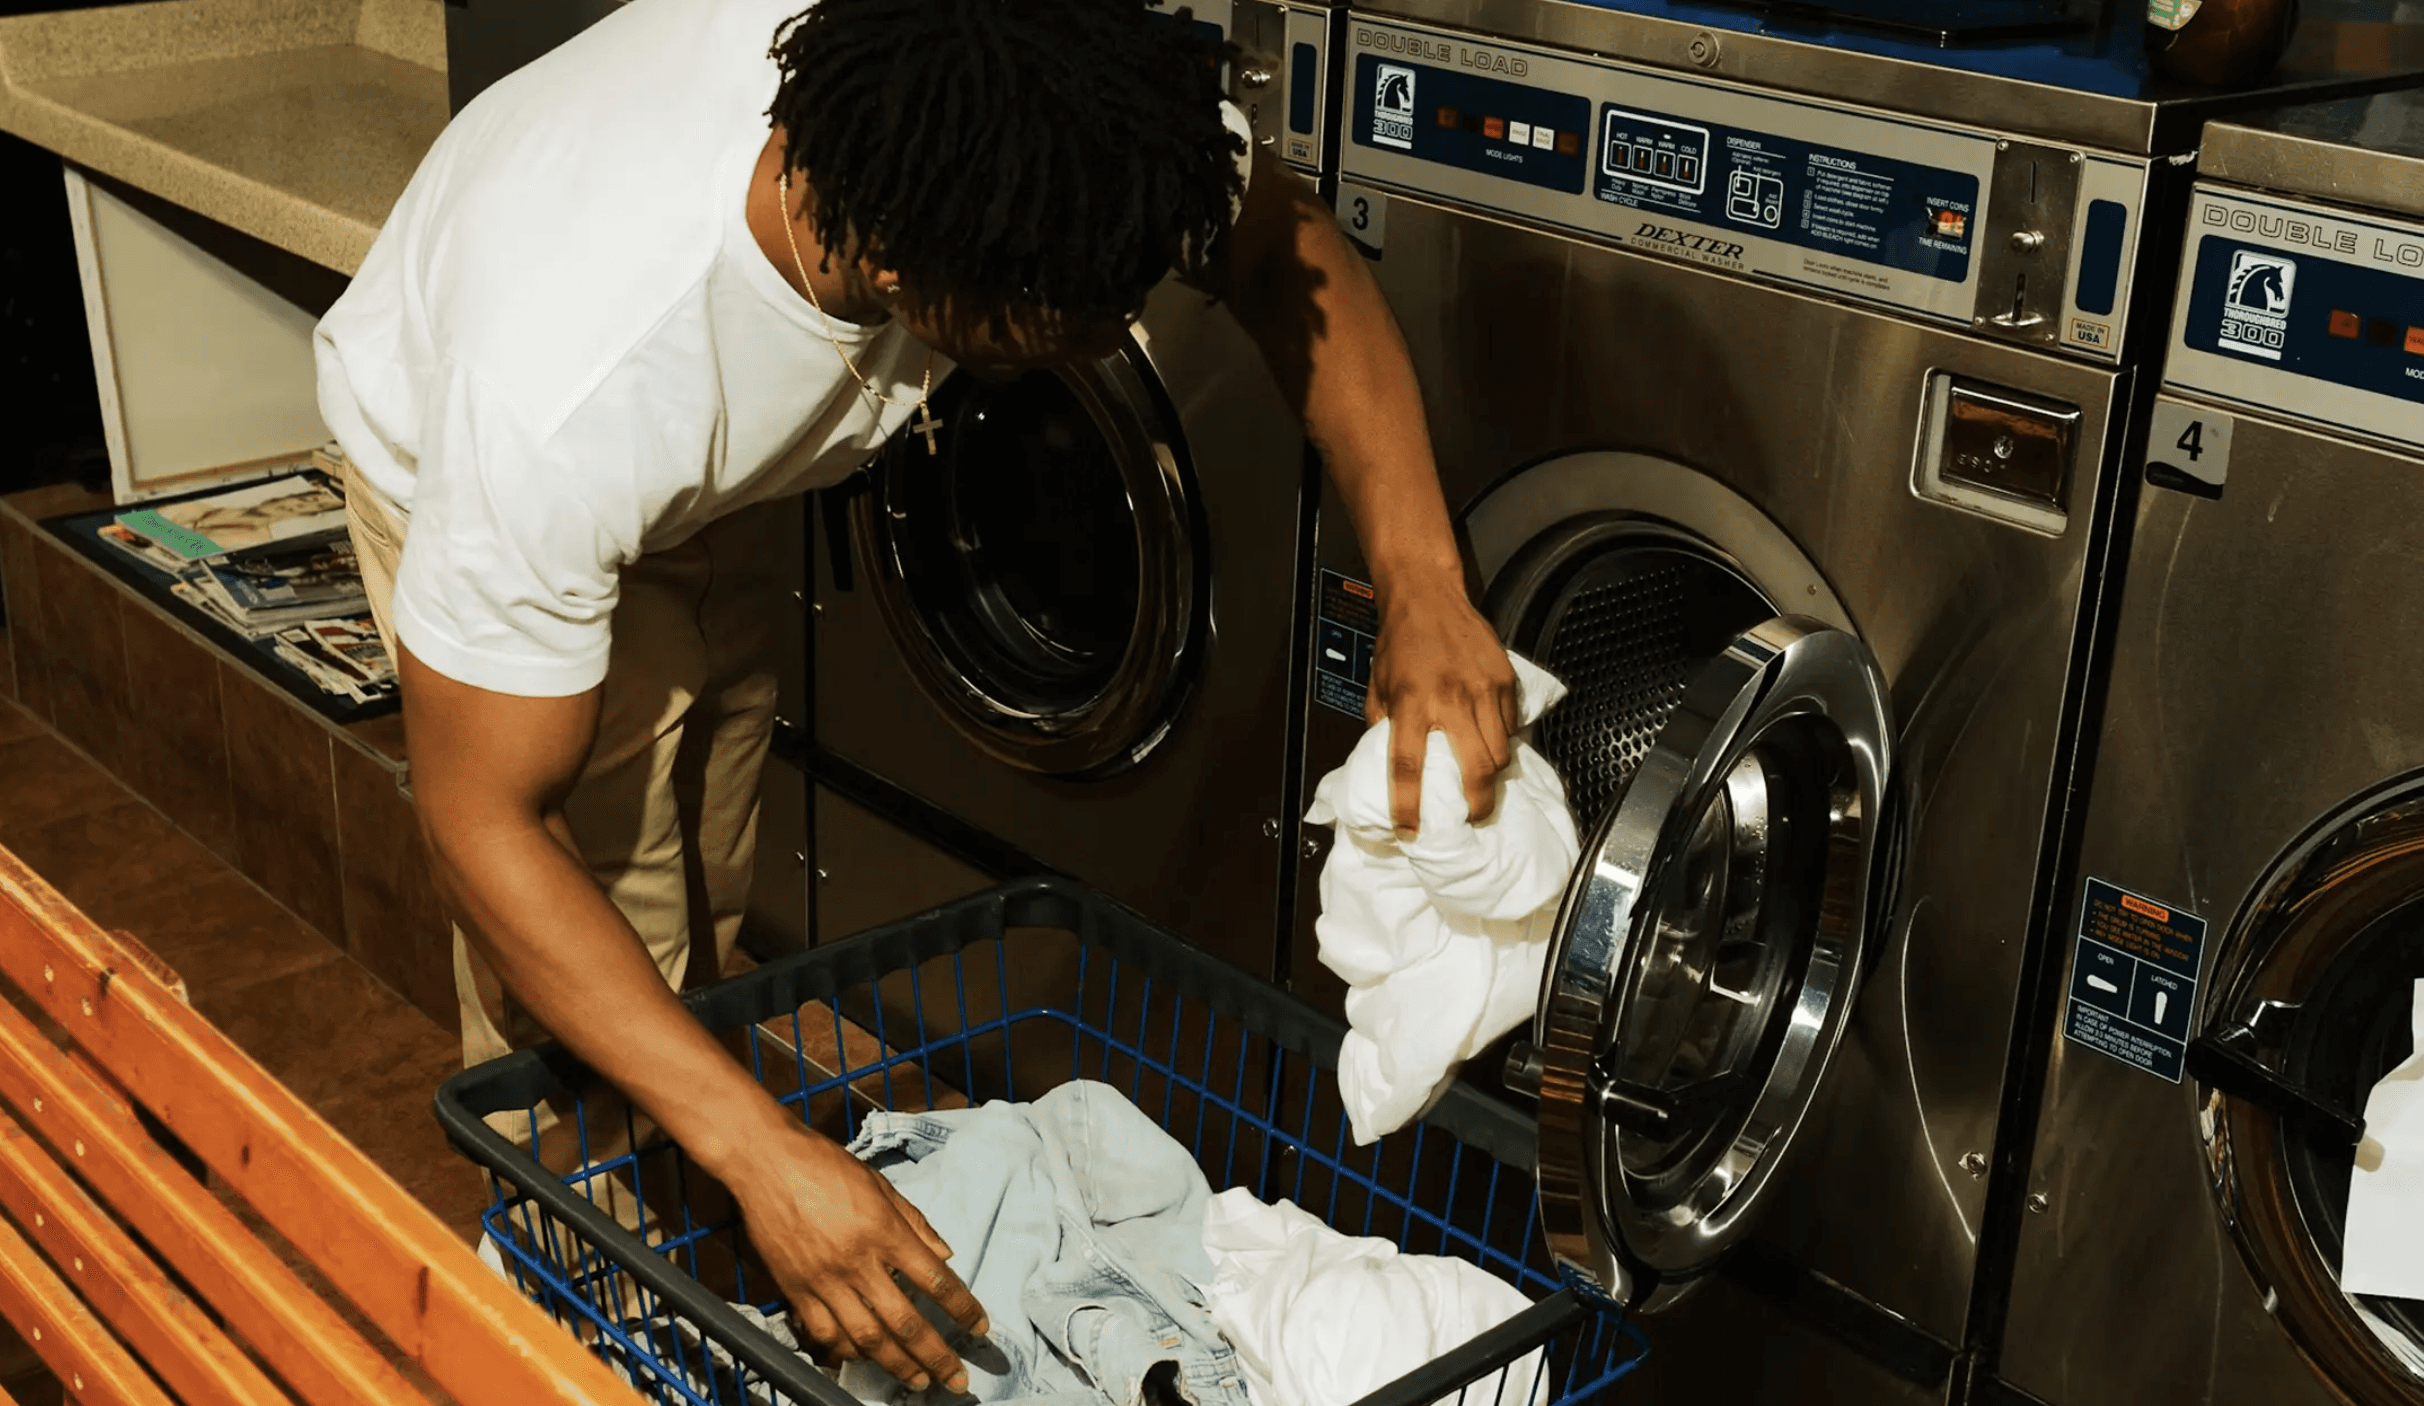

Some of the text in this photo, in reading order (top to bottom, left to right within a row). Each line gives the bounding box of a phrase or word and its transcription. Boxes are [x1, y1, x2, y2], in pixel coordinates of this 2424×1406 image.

[1357, 28, 1527, 78] DOUBLE LOAD
[1373, 119, 1413, 140] 300
[1680, 145, 1697, 154] COLD
[1727, 136, 1761, 150] DISPENSER
[1808, 153, 1857, 170] INSTRUCTIONS
[1352, 197, 1369, 230] 3
[1926, 196, 1970, 213] INSERT COINS
[2202, 203, 2358, 254] DOUBLE
[1634, 223, 1744, 260] DEXTER
[1918, 236, 1967, 255] TIME REMAINING
[1631, 238, 1745, 271] COMMERCIAL WASHER
[2076, 322, 2095, 332] MADE
[2224, 307, 2287, 330] THOROUGHBRED
[2078, 331, 2100, 344] USA
[2220, 318, 2285, 349] 300
[2176, 420, 2203, 462] 4
[2126, 897, 2165, 919] WARNING
[2097, 953, 2114, 965] OPEN
[2151, 975, 2178, 990] LATCHED
[2083, 1015, 2098, 1028] CASE
[2108, 1026, 2130, 1039] POWER
[2074, 1021, 2094, 1034] ALLOW
[2104, 1033, 2129, 1049] MINUTES
[2130, 1044, 2153, 1059] BEFORE
[2074, 1029, 2108, 1048] ATTEMPTING
[2118, 1047, 2134, 1059] OPEN
